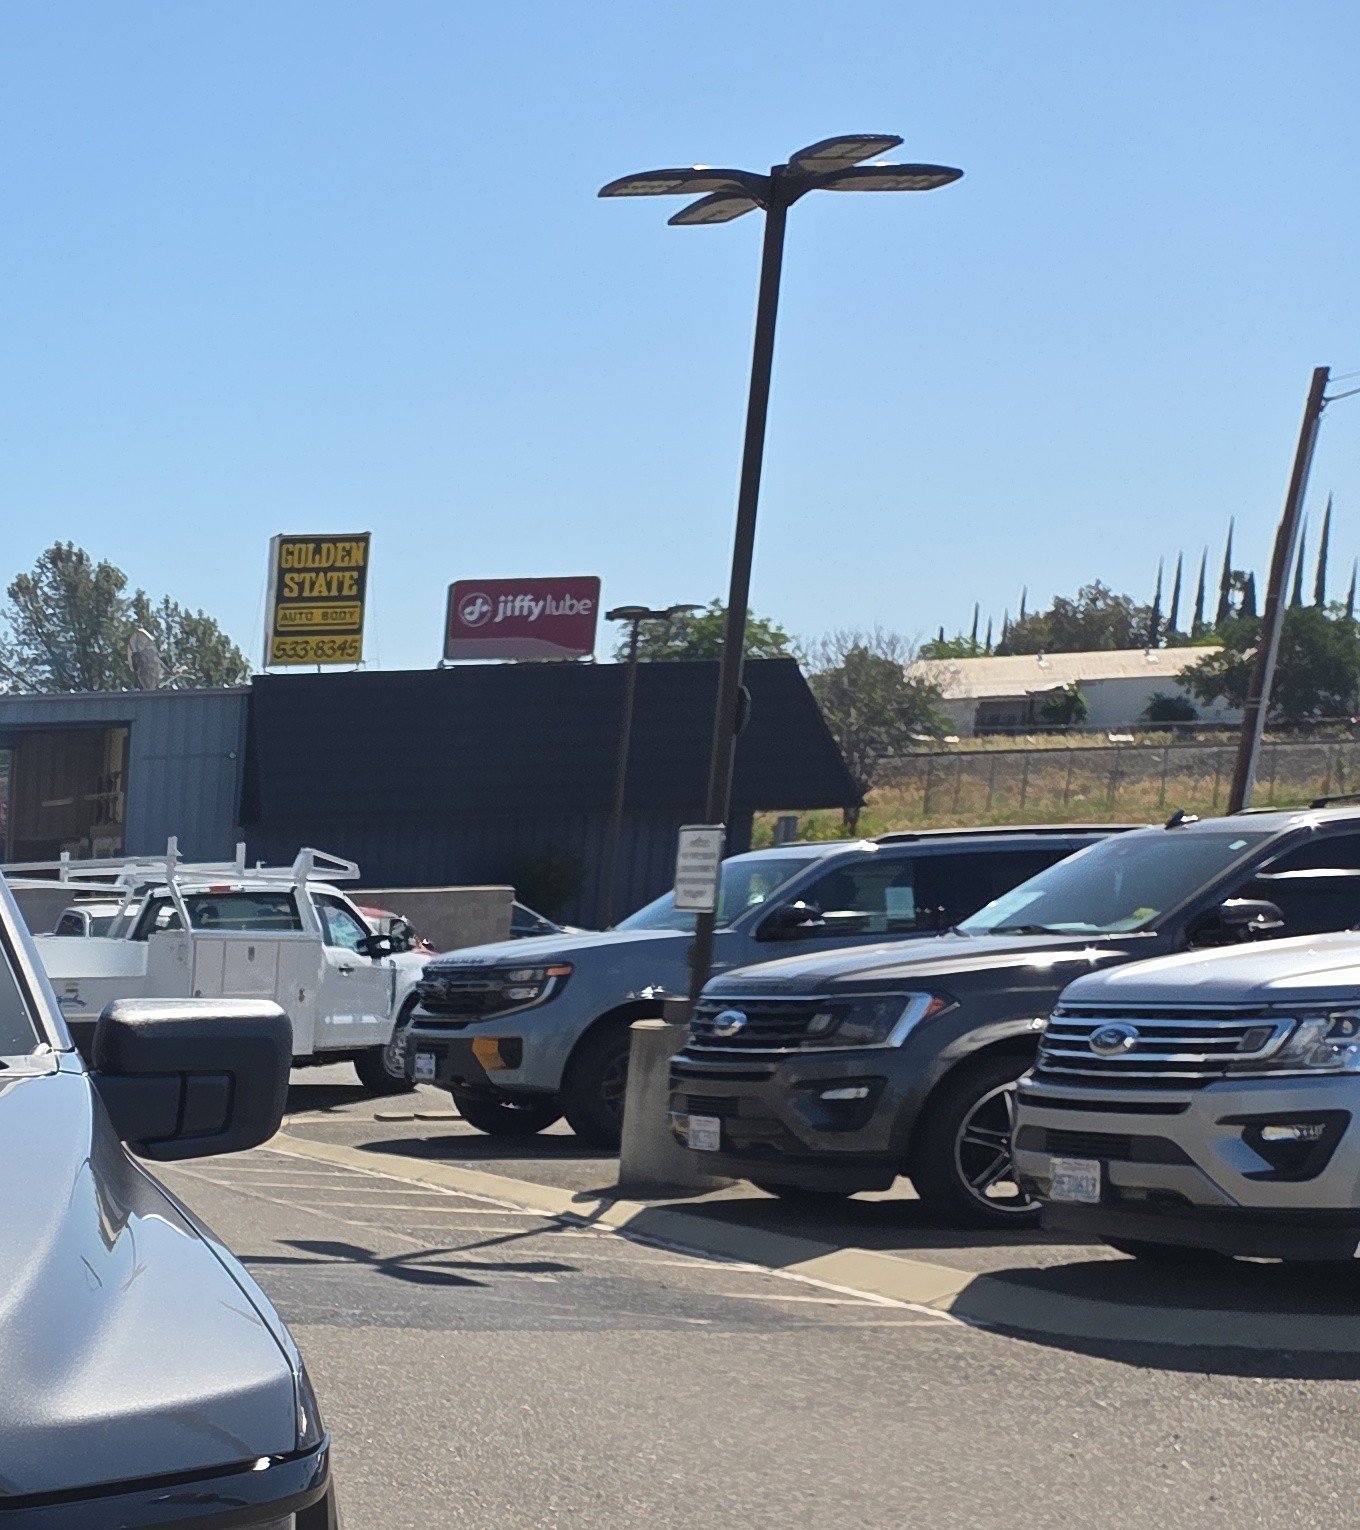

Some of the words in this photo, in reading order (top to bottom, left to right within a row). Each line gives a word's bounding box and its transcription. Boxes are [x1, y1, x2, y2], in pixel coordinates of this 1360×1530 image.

[281, 542, 366, 568] GOLDEN
[283, 571, 358, 597] STATE
[280, 610, 313, 622] AUTO
[321, 610, 357, 621] BODY
